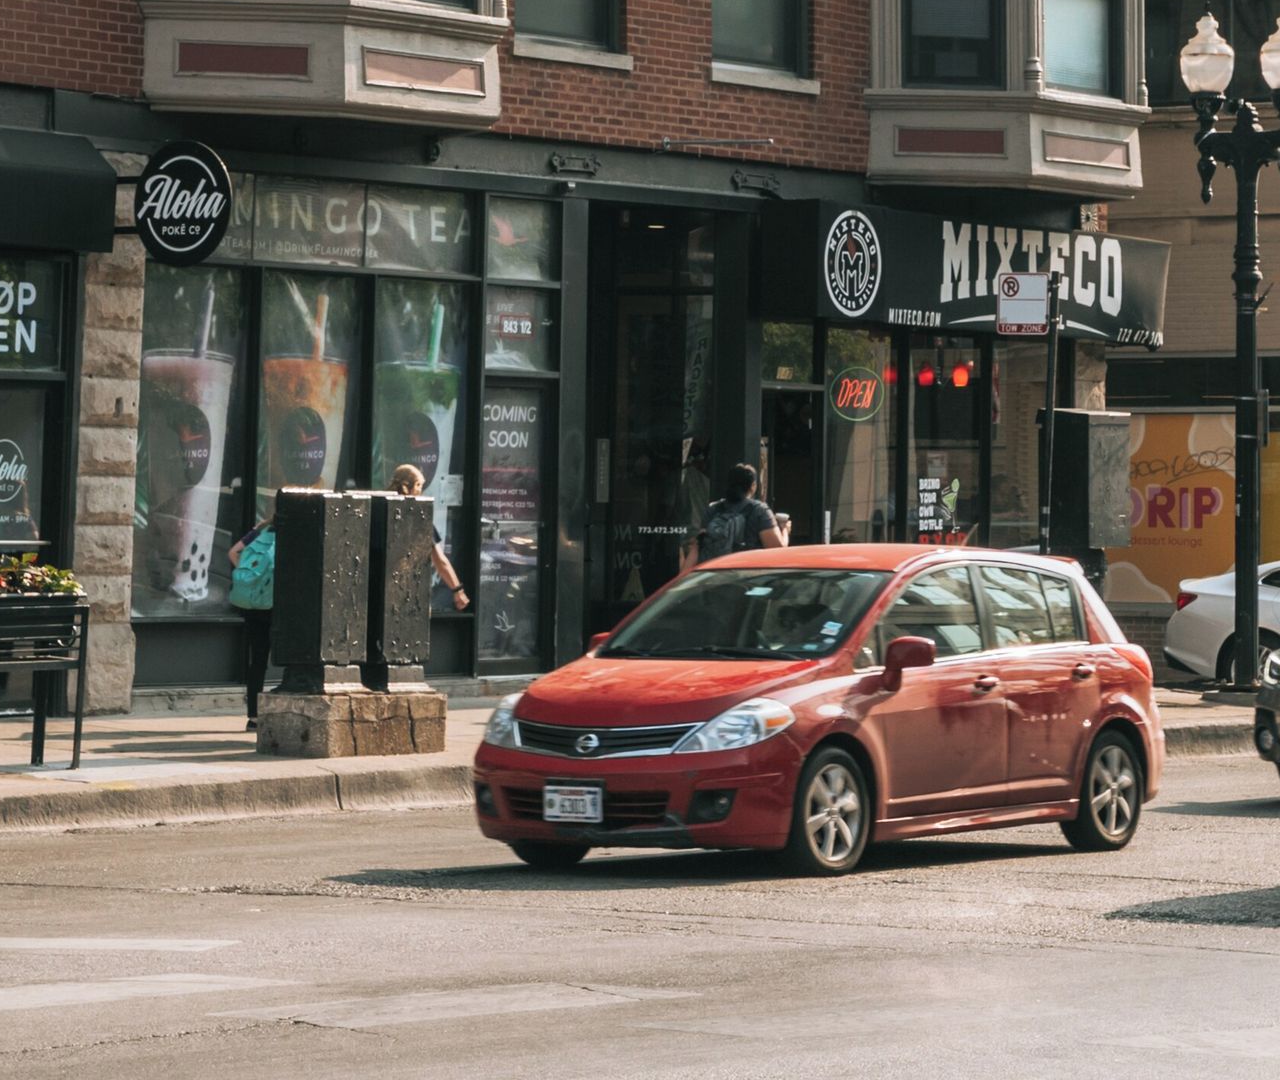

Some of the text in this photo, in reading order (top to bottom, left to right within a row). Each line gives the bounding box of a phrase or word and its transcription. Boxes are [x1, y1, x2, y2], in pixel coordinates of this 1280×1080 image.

[137, 174, 227, 220] Aloha
[829, 218, 877, 256] MIXTECO
[940, 220, 1123, 317] MIXTECO
[503, 320, 519, 334] 843
[888, 307, 942, 327] MIXTECO.COM
[1001, 324, 1044, 333] TOW ZONE
[836, 378, 878, 409] OPEN
[482, 404, 537, 423] COMING
[487, 430, 529, 449] SOON
